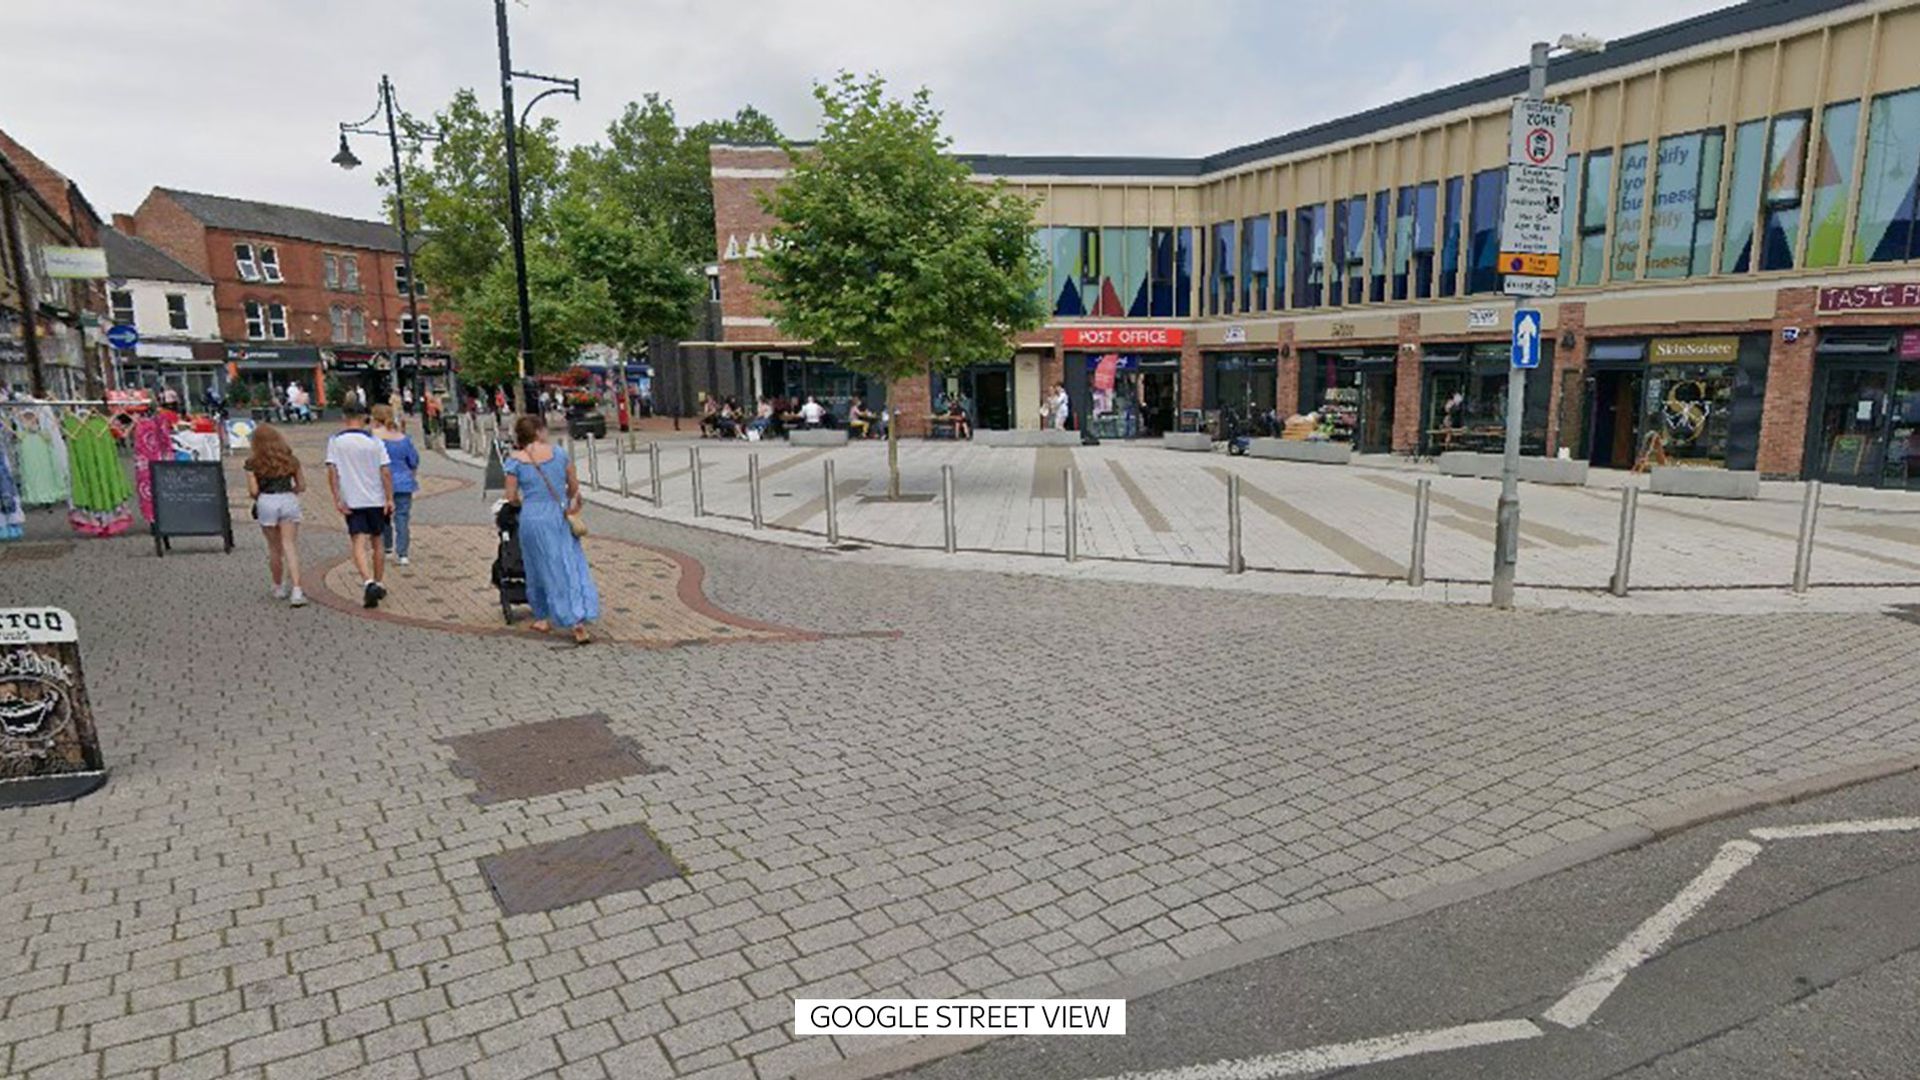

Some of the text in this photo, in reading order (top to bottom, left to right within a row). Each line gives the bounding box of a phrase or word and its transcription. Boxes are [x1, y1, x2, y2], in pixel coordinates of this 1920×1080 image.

[1527, 113, 1556, 128] ZONE
[1826, 285, 1896, 308] TASTE
[1078, 330, 1168, 343] POST OFFICE
